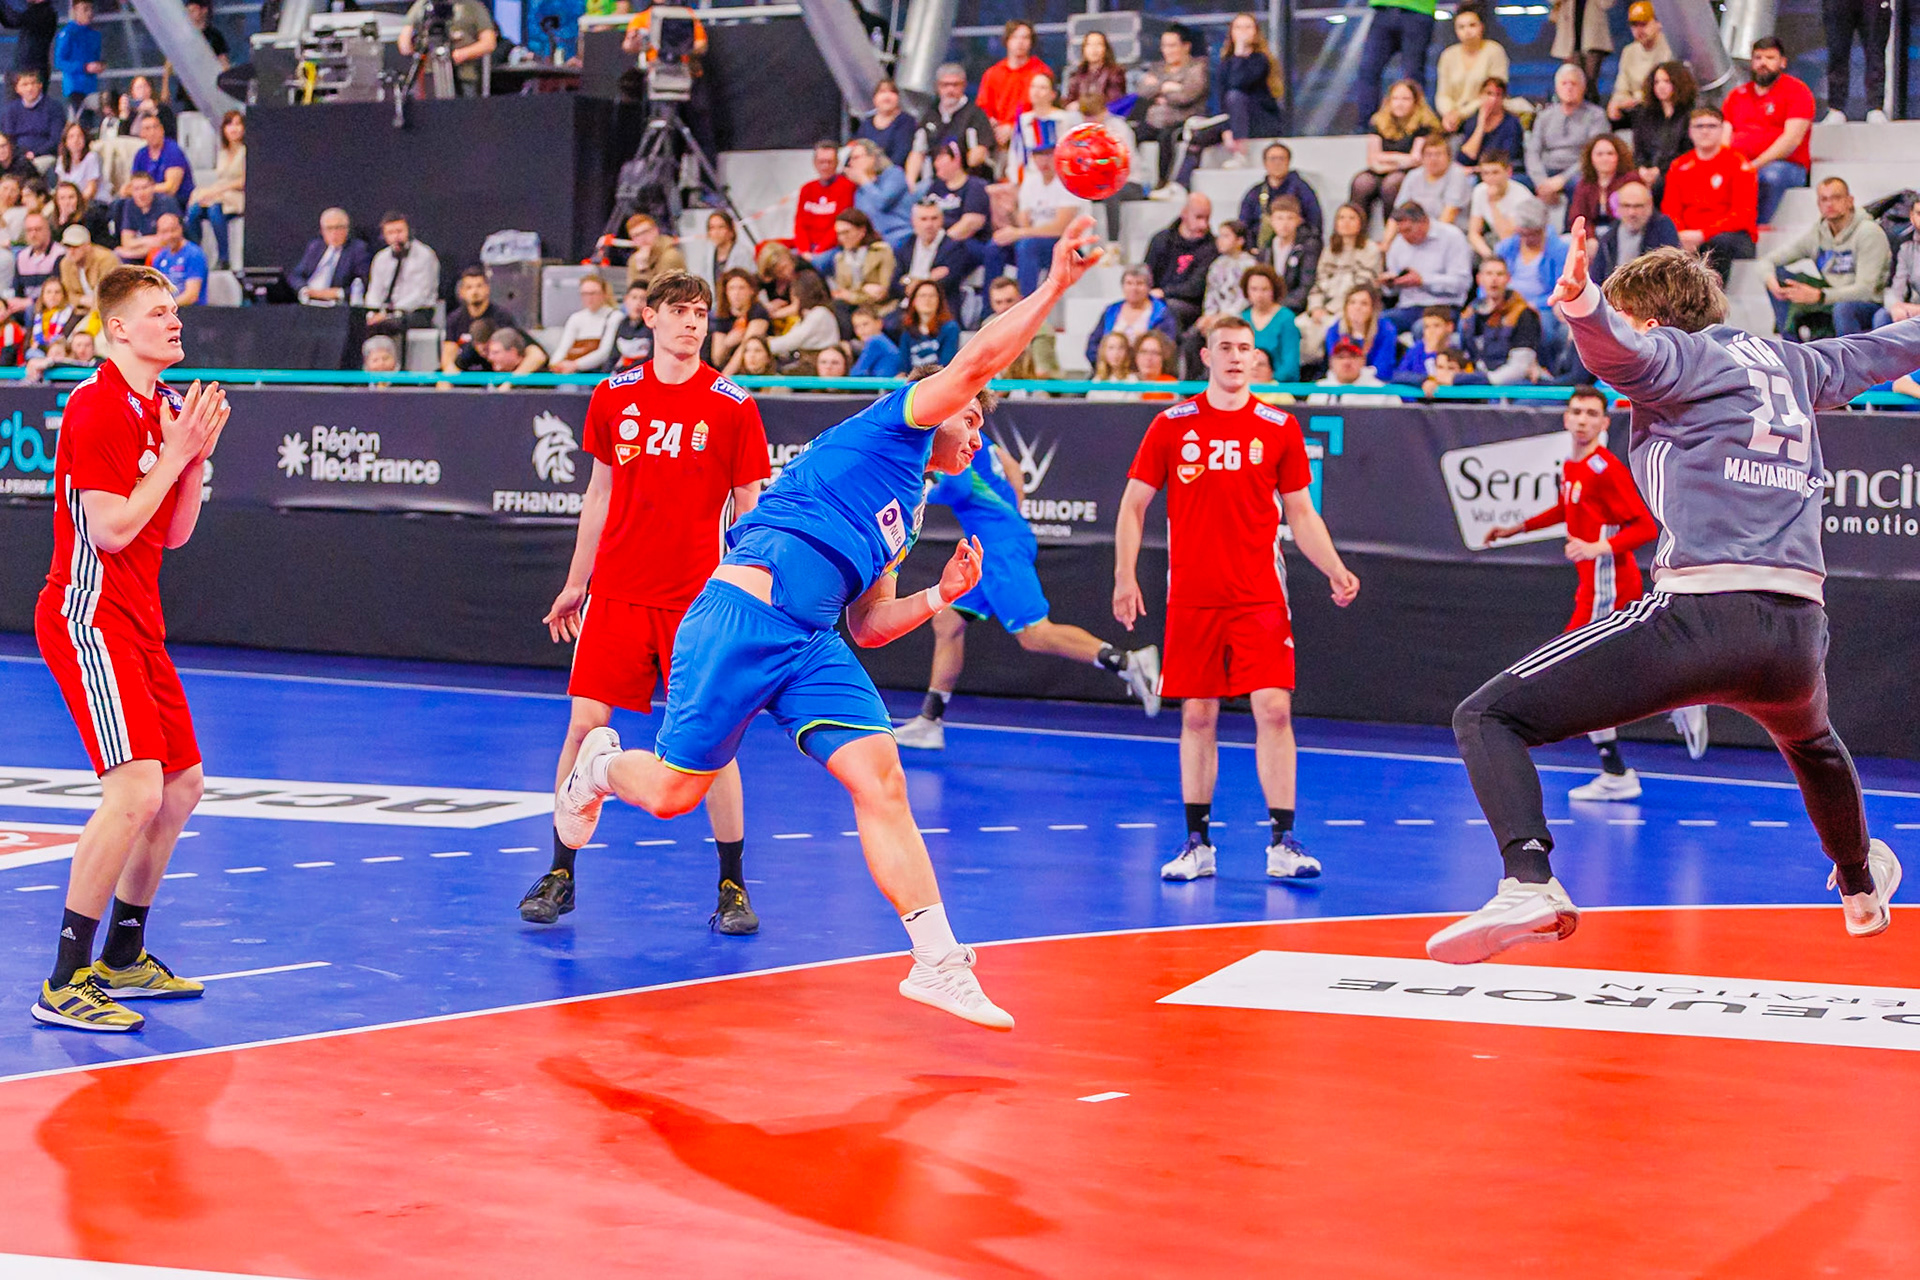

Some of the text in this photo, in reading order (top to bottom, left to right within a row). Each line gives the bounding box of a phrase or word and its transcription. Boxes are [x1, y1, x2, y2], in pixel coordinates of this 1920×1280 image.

[1747, 368, 1811, 463] 23
[311, 425, 381, 459] Région
[645, 419, 683, 458] 24
[1208, 439, 1242, 471] 26
[1021, 499, 1098, 523] EUROPE
[888, 524, 903, 547] NLB
